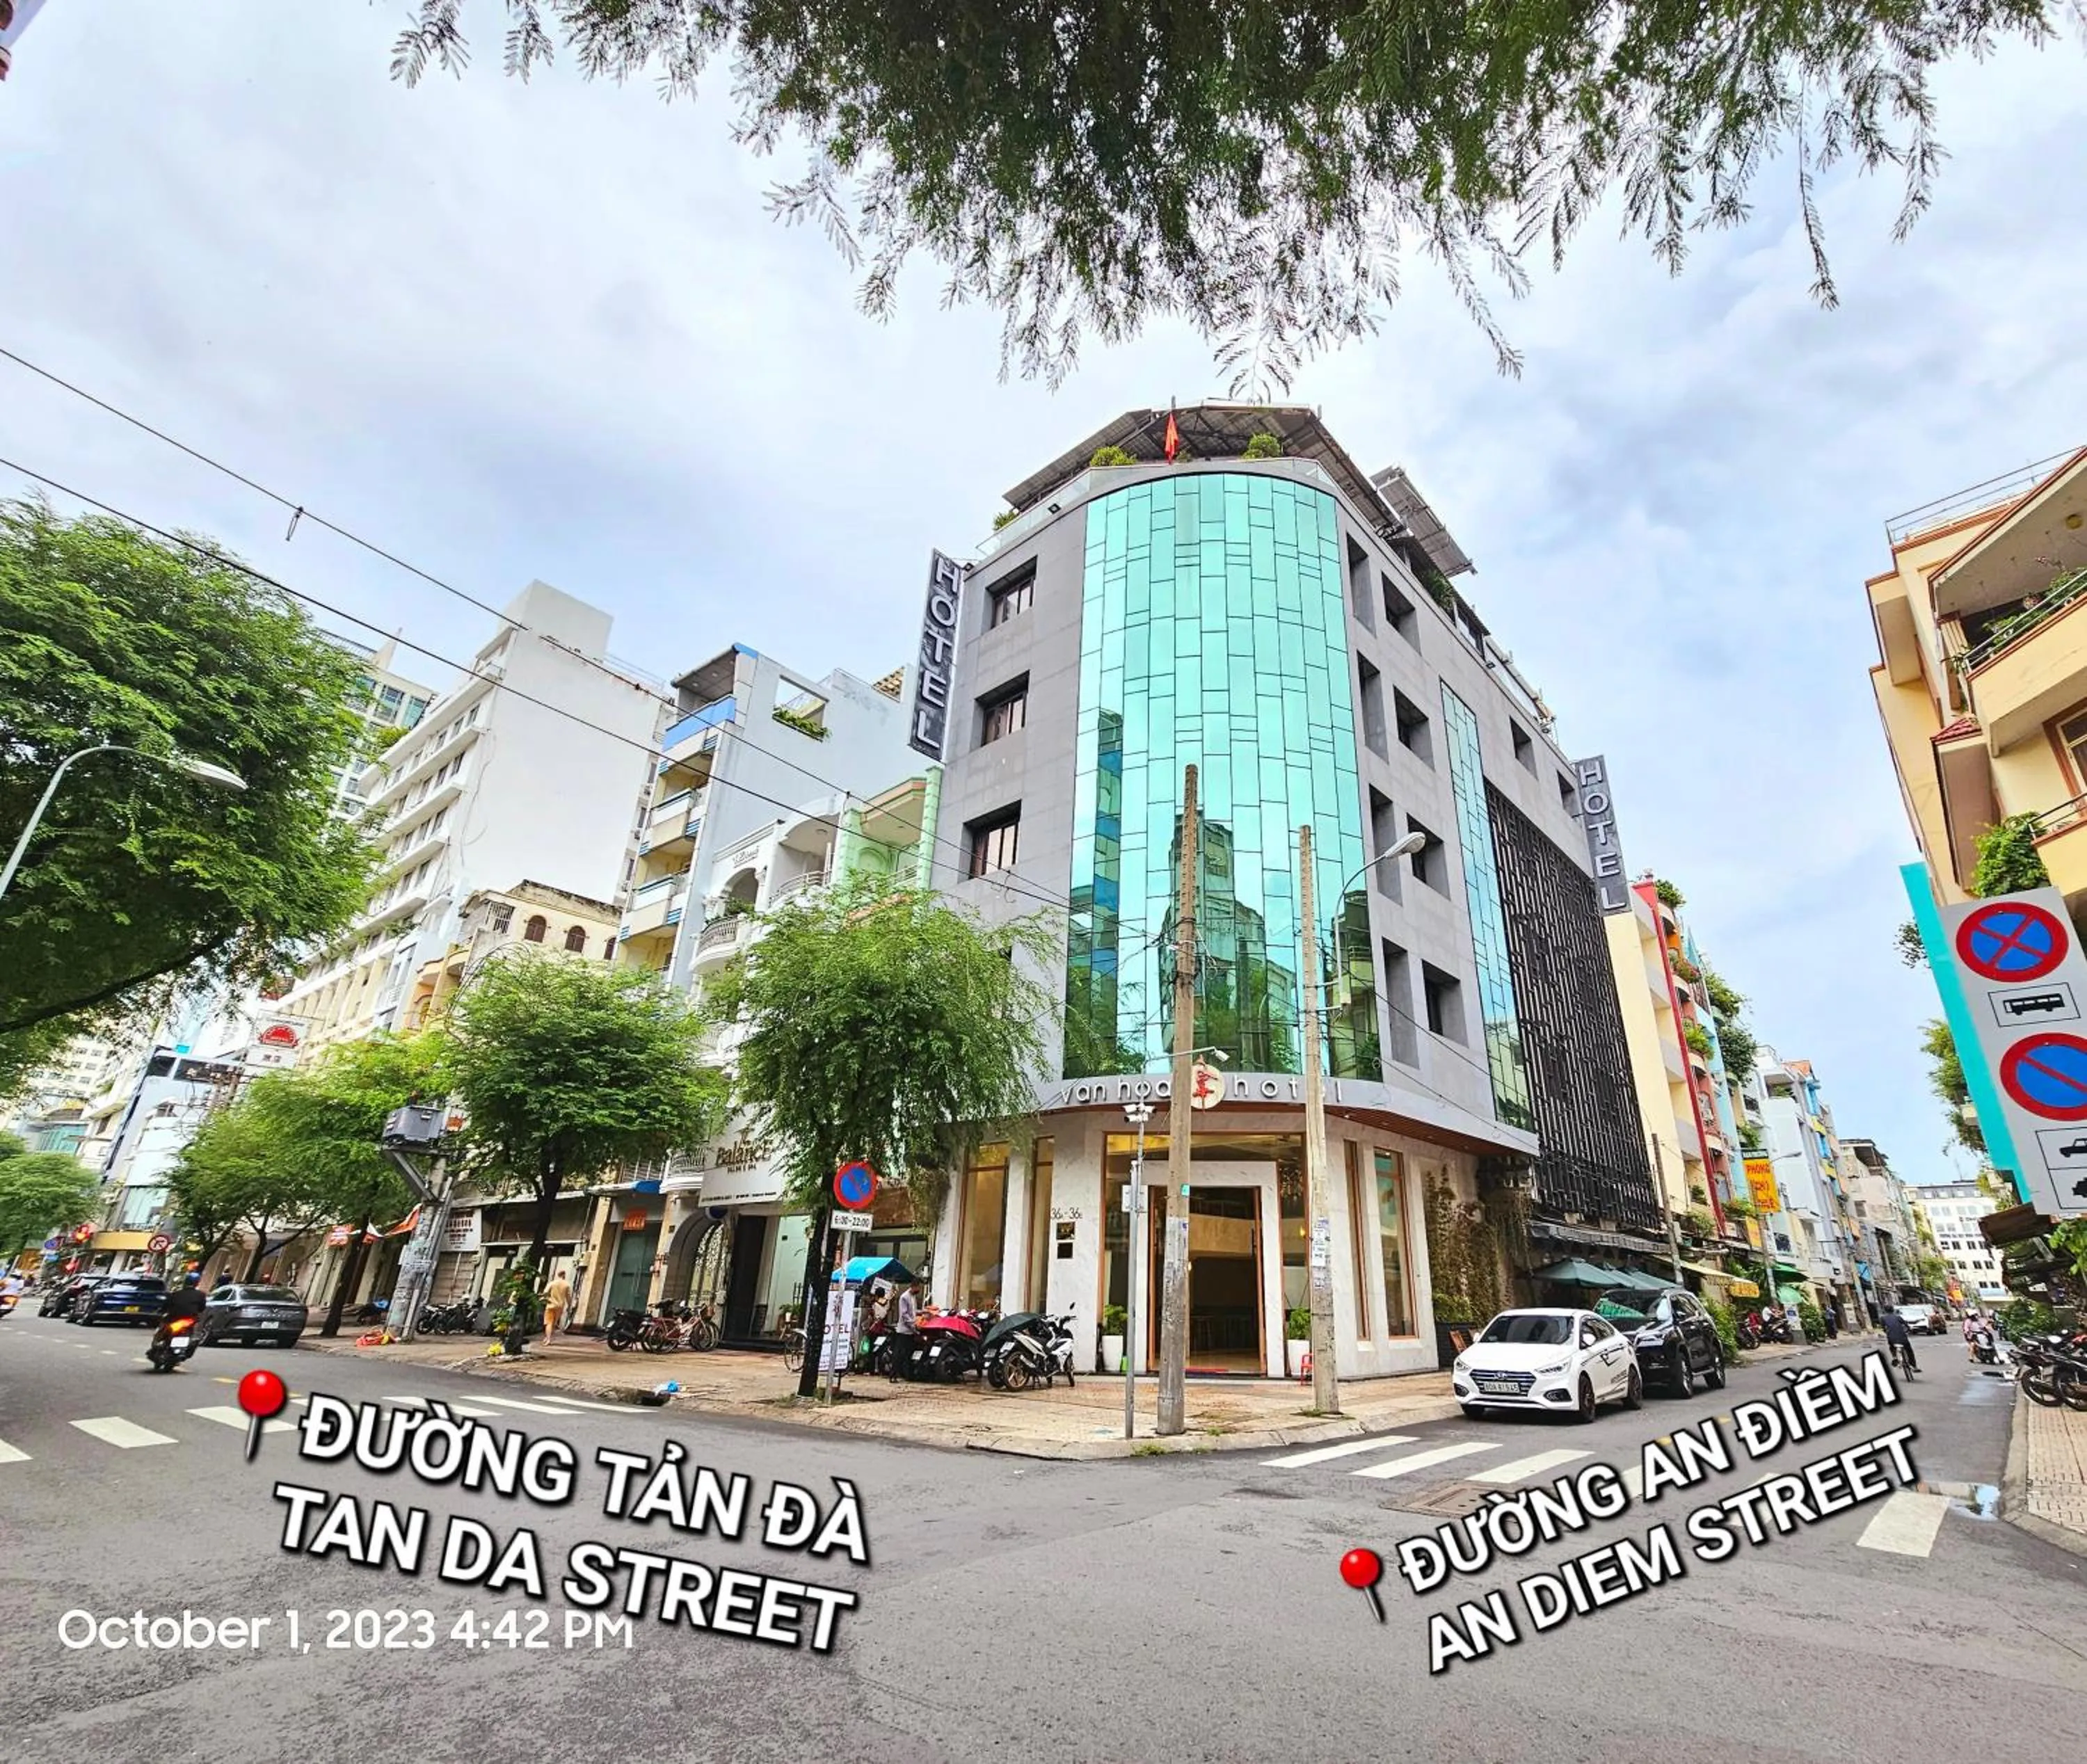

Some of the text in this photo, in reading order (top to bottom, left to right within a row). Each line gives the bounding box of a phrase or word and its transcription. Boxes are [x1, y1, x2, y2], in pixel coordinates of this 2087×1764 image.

[916, 557, 959, 749] HOTEL
[1578, 761, 1626, 910] HOTEL
[1061, 1082, 1107, 1105] van
[1118, 1076, 1172, 1100] hoa
[1233, 1074, 1342, 1102] hotl
